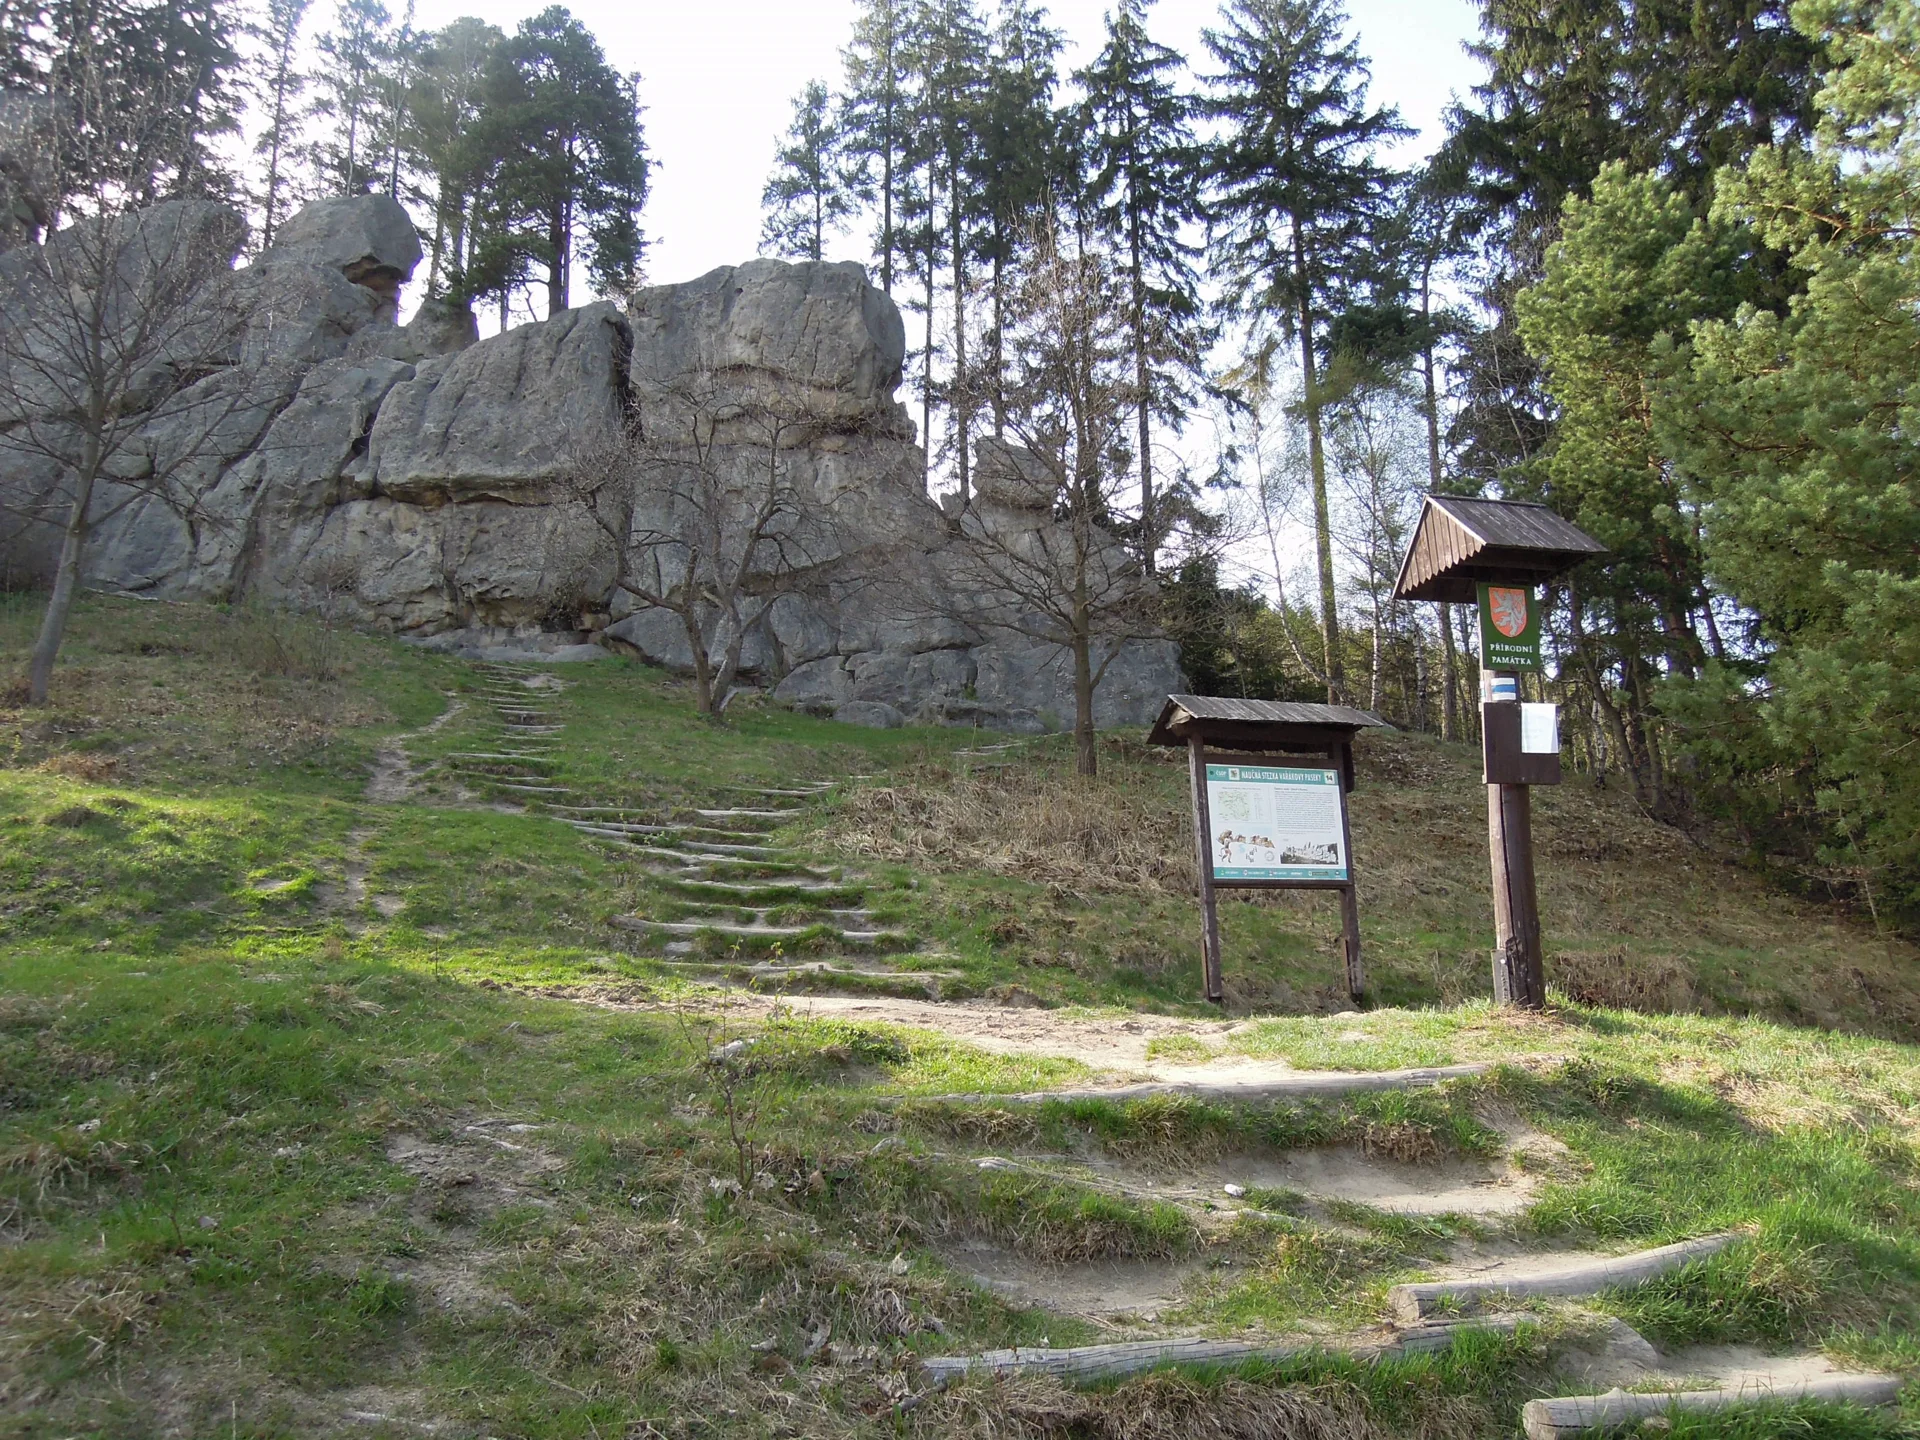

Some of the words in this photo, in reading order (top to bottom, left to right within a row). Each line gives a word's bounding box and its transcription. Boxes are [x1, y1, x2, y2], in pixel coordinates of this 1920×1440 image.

[1489, 642, 1533, 653] PŘÍRODNÍ
[1491, 656, 1532, 665] PAMÁTKA
[1261, 771, 1279, 780] STEZKA
